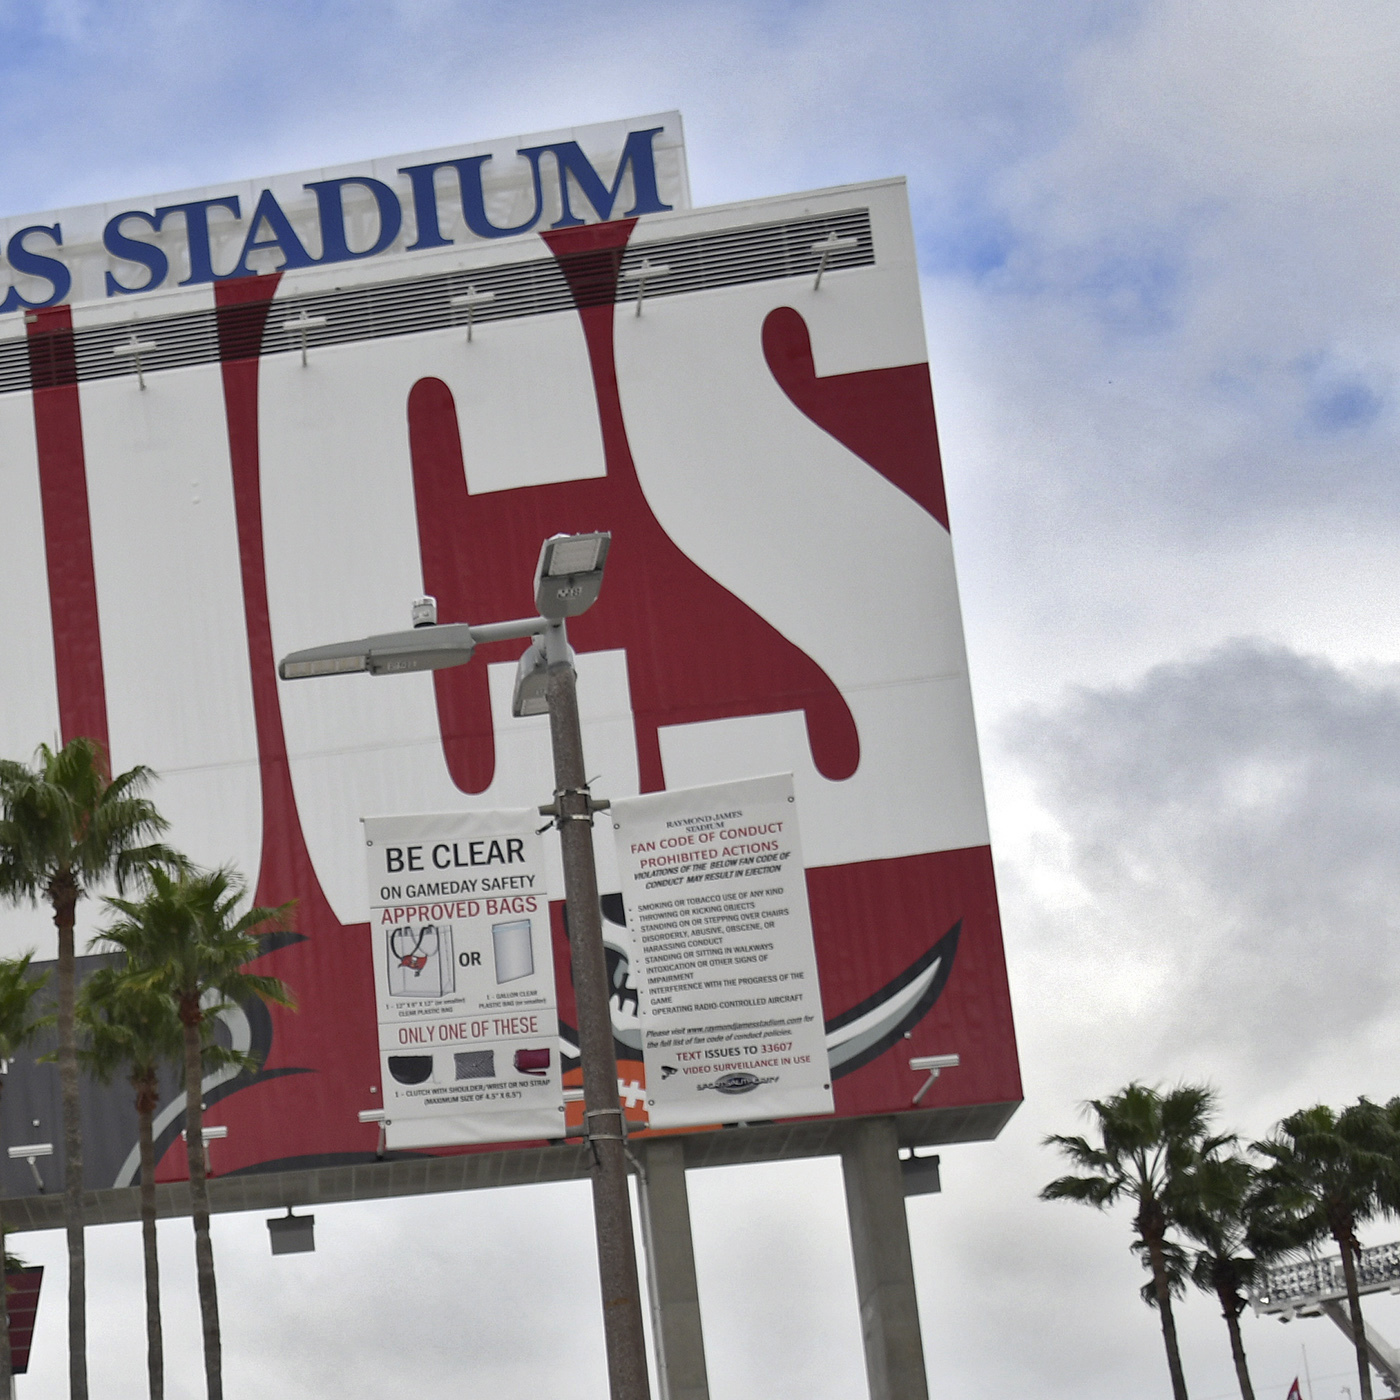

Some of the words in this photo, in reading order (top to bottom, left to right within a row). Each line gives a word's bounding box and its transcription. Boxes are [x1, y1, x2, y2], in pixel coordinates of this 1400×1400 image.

[103, 127, 673, 297] STADIUM
[666, 816, 712, 828] RAYMOND
[712, 811, 743, 821] JAMES
[686, 822, 724, 833] STADIUM
[630, 842, 655, 854] FAN
[660, 835, 694, 849] CODE
[699, 832, 716, 843] OF
[720, 822, 783, 840] CONDUCT
[386, 846, 424, 873] BE
[432, 839, 525, 869] CLEAR
[640, 849, 717, 869] PROHIBITED
[722, 841, 779, 857] ACTIONS
[634, 865, 678, 880] VIOLATIONS
[680, 864, 691, 873] OF
[693, 863, 706, 871] THE
[710, 859, 738, 869] BELOW
[739, 855, 754, 865] FAN
[756, 853, 777, 863] CODE
[780, 852, 791, 860] OF
[381, 886, 401, 900] ON
[406, 880, 478, 898] GAMEDAY
[482, 875, 535, 891] SAFETY
[646, 878, 683, 889] CONDUCT
[686, 875, 702, 883] MAY
[704, 870, 734, 881] RESULT
[745, 865, 781, 876] EJECTION
[381, 901, 480, 925] APPROVED
[486, 896, 537, 915] BAGS
[638, 901, 673, 912] SMOKING
[687, 895, 721, 905] TOBACCO
[722, 893, 737, 901] USE
[750, 890, 763, 898] ANY
[639, 911, 678, 922] THROWING
[692, 906, 722, 915] KICKING
[724, 902, 755, 911] OBJECTS
[641, 922, 677, 933] STANDING
[704, 915, 739, 924] STEPPING
[761, 909, 789, 918] CHAIRS
[642, 932, 689, 943] DISORDERLY,
[691, 928, 724, 936] ABUSIVE,
[726, 924, 762, 933] OBSCENE,
[459, 952, 481, 966] OR
[645, 954, 682, 964] STANDING
[696, 948, 723, 957] SITTING
[734, 943, 773, 953] WALKWAYS
[646, 963, 696, 974] INTOXICATION
[698, 960, 708, 968] OR
[710, 958, 732, 966] OTHER
[734, 956, 757, 964] SIGNS
[649, 983, 702, 995] INTERFERENCE
[704, 980, 721, 988] WITH
[738, 975, 777, 985] PROGRESS
[652, 1005, 693, 1015] OPERATING
[695, 998, 766, 1010] RADIO-CONTROLLED
[768, 994, 803, 1004] AIRCRAFT
[399, 1026, 435, 1044] ONLY
[439, 1023, 467, 1041] ONE
[471, 1021, 489, 1037] OF
[492, 1016, 538, 1035] THESE
[677, 1052, 701, 1061] TEXT
[705, 1047, 740, 1058] ISSUES
[743, 1046, 757, 1054] TO
[761, 1042, 793, 1053] 33607
[683, 1066, 710, 1074] VIDEO
[713, 1059, 778, 1072] SURVEILLANCE
